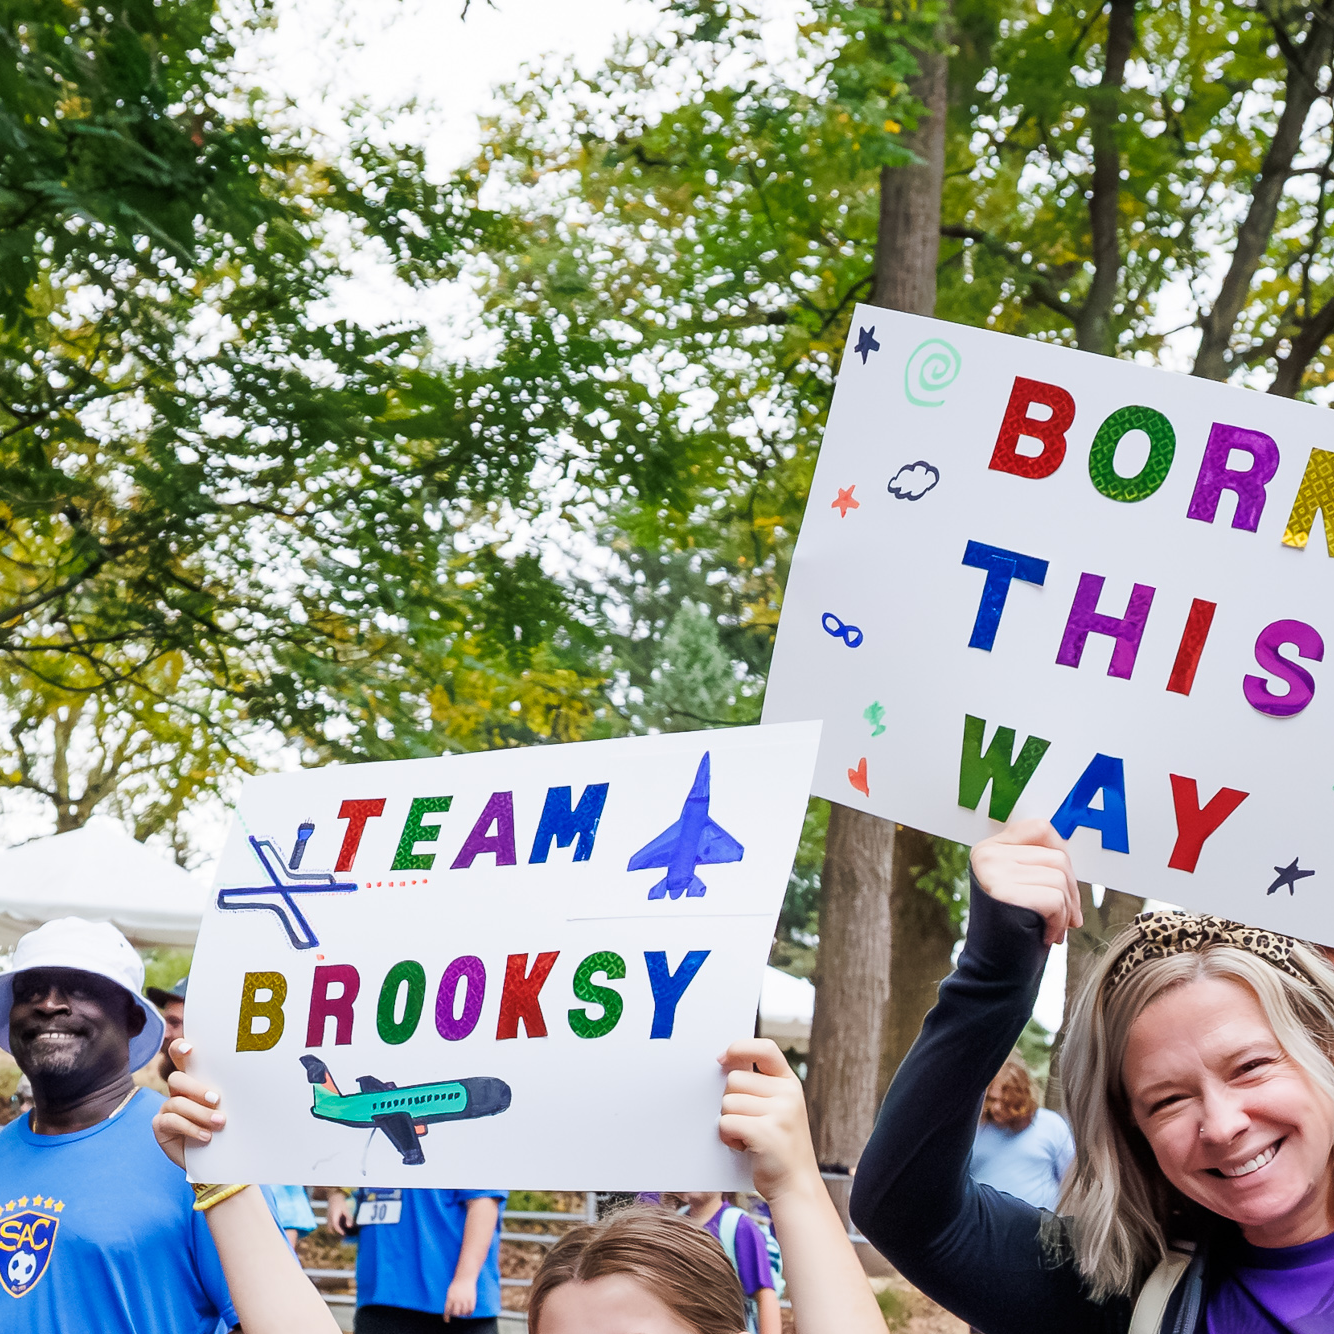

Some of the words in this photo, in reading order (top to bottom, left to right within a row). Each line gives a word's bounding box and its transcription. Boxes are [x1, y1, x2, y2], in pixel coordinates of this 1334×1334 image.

[961, 538, 1325, 719] THIS
[334, 782, 609, 873] TEAM
[957, 713, 1250, 873] WAY
[235, 950, 711, 1053] BROOKSY
